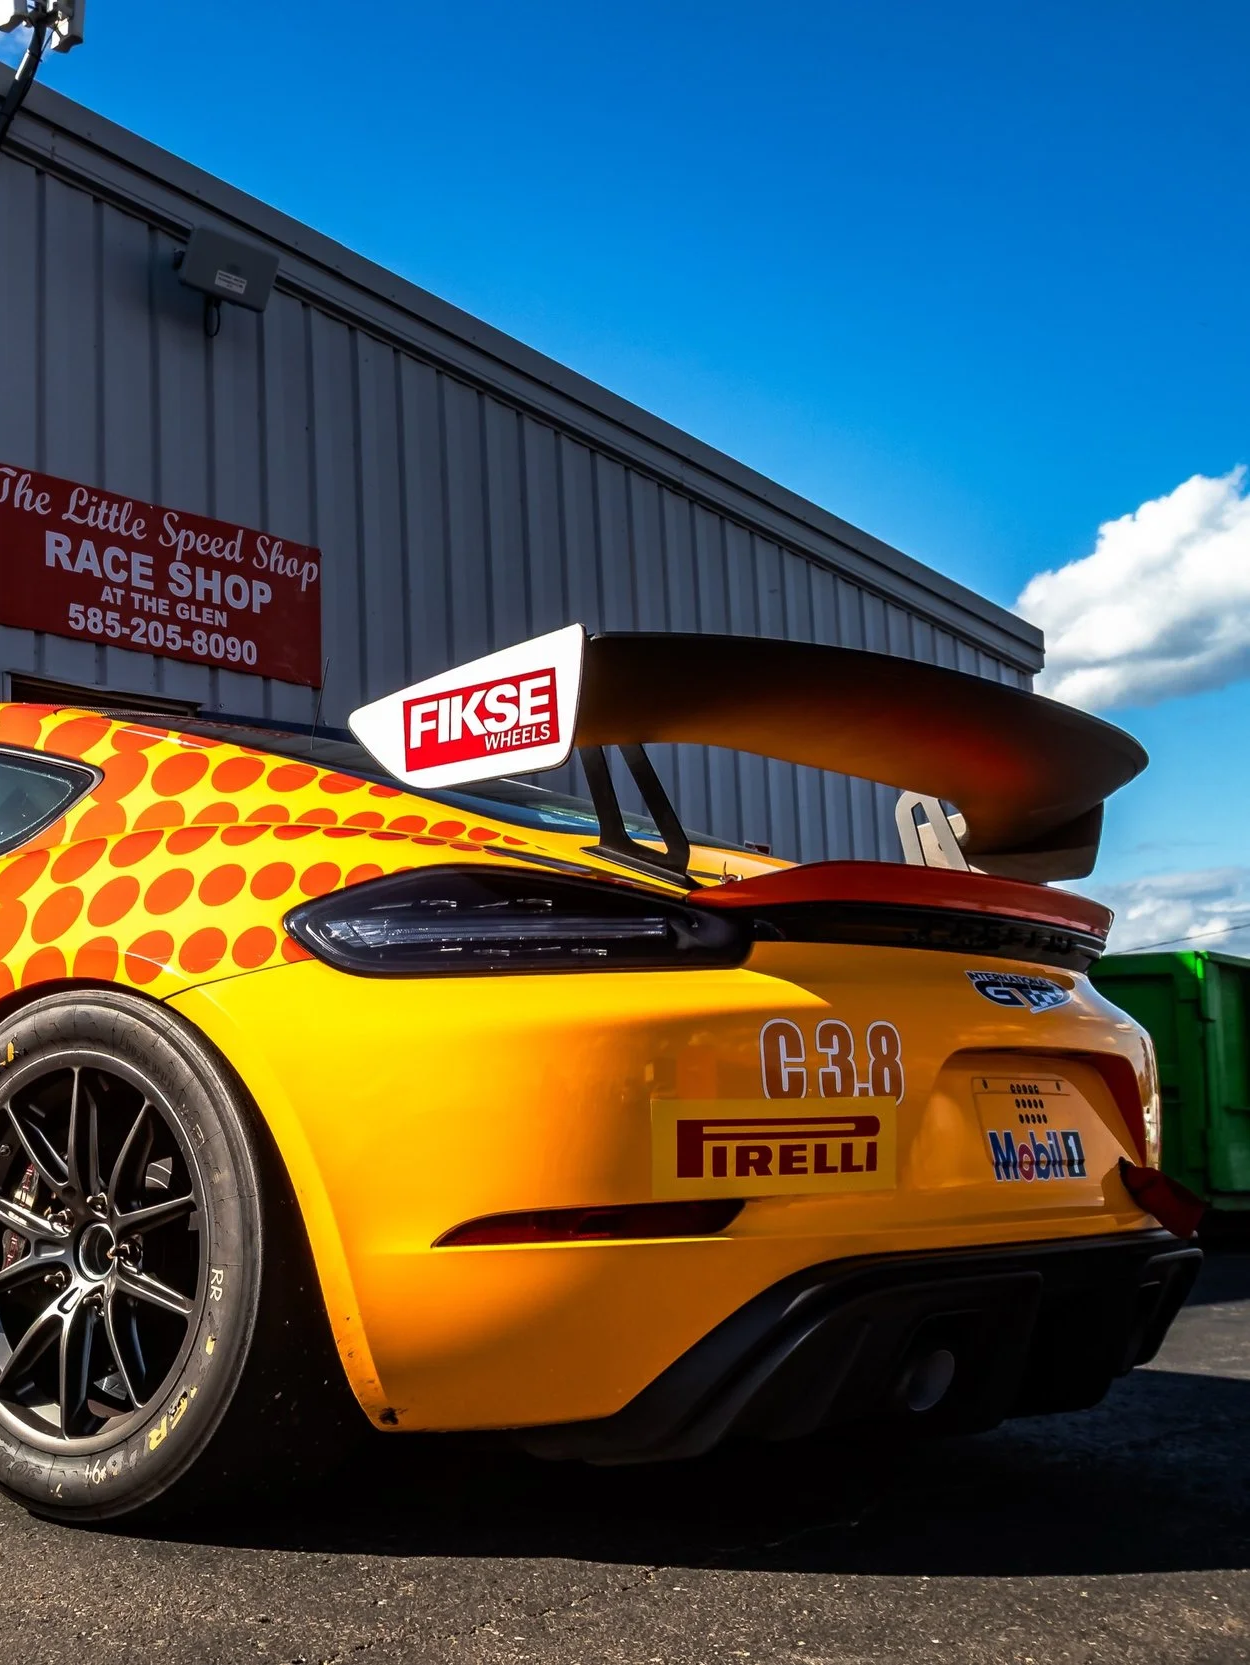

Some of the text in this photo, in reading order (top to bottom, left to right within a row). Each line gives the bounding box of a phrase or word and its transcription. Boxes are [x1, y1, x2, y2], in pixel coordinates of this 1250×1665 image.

[61, 487, 148, 541] Little
[158, 511, 245, 561] Speed
[252, 534, 319, 592] Shop
[44, 530, 273, 614] RACE SHOP
[67, 602, 258, 666] 585-205-8090
[100, 585, 228, 628] AT THE GLEN
[408, 674, 552, 750] FIKSE
[484, 722, 552, 752] WHEELS
[676, 1115, 881, 1179] PIRELLI
[987, 1130, 1065, 1182] Mobil
[210, 1268, 224, 1303] RR
